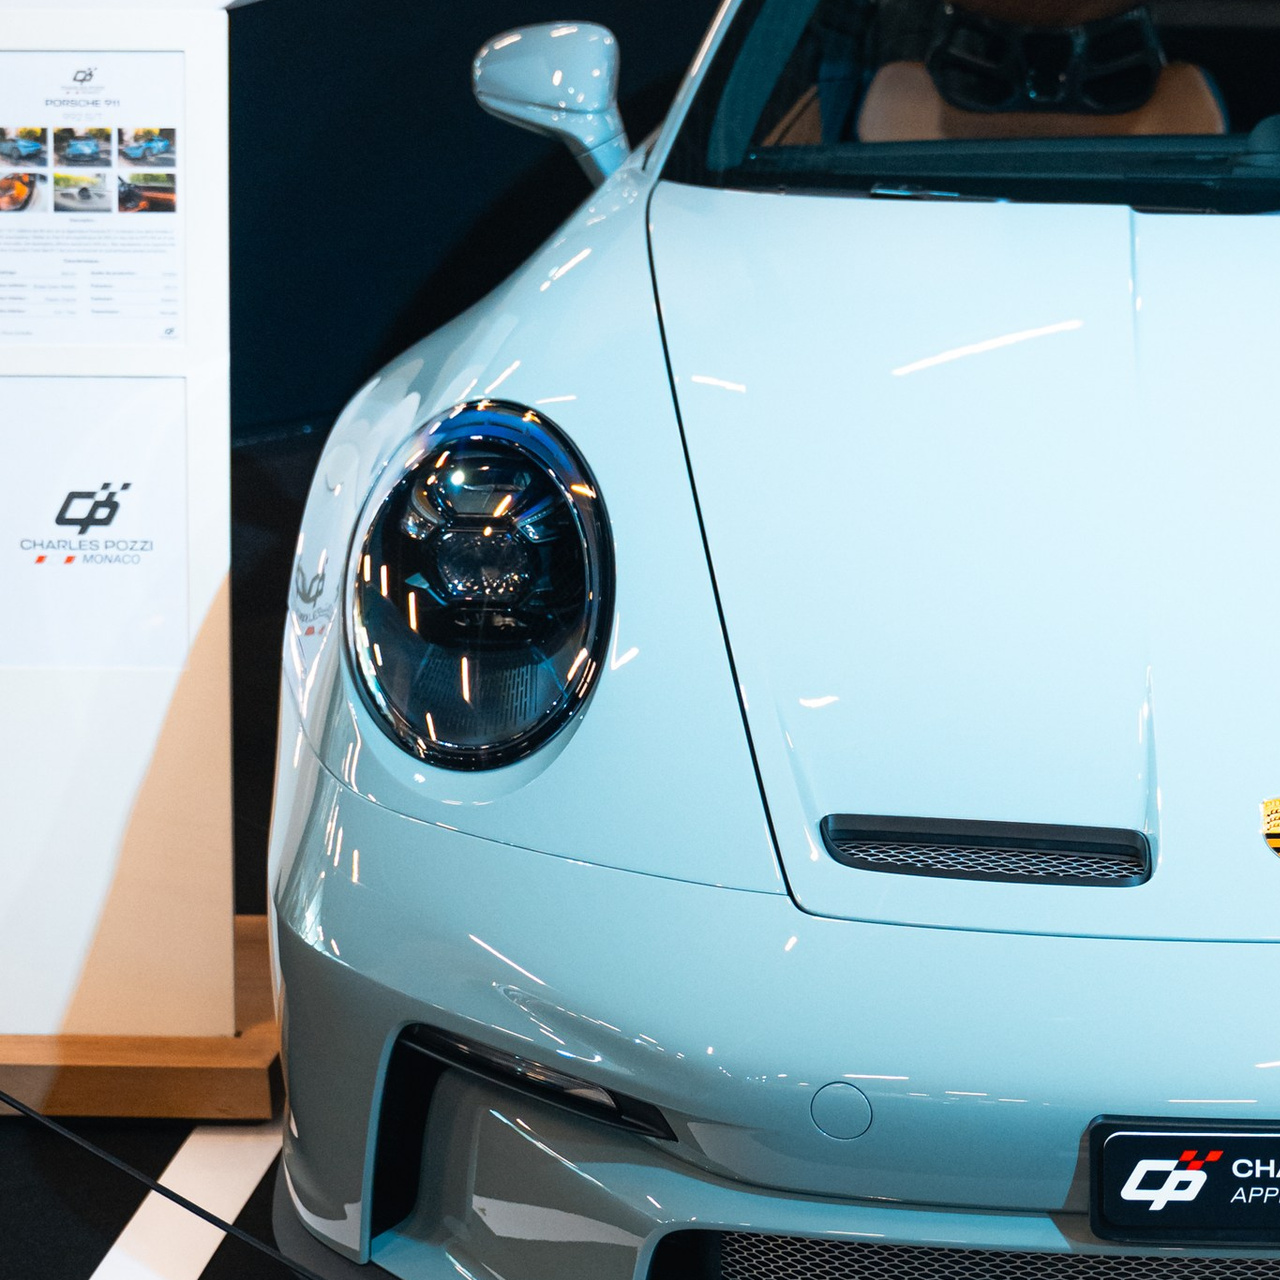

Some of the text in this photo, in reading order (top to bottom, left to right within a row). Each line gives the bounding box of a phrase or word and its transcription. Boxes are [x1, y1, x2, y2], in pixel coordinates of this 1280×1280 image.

[45, 99, 101, 108] PORSCHE
[20, 539, 154, 552] CHARLES POZZI
[82, 554, 141, 565] MONACO
